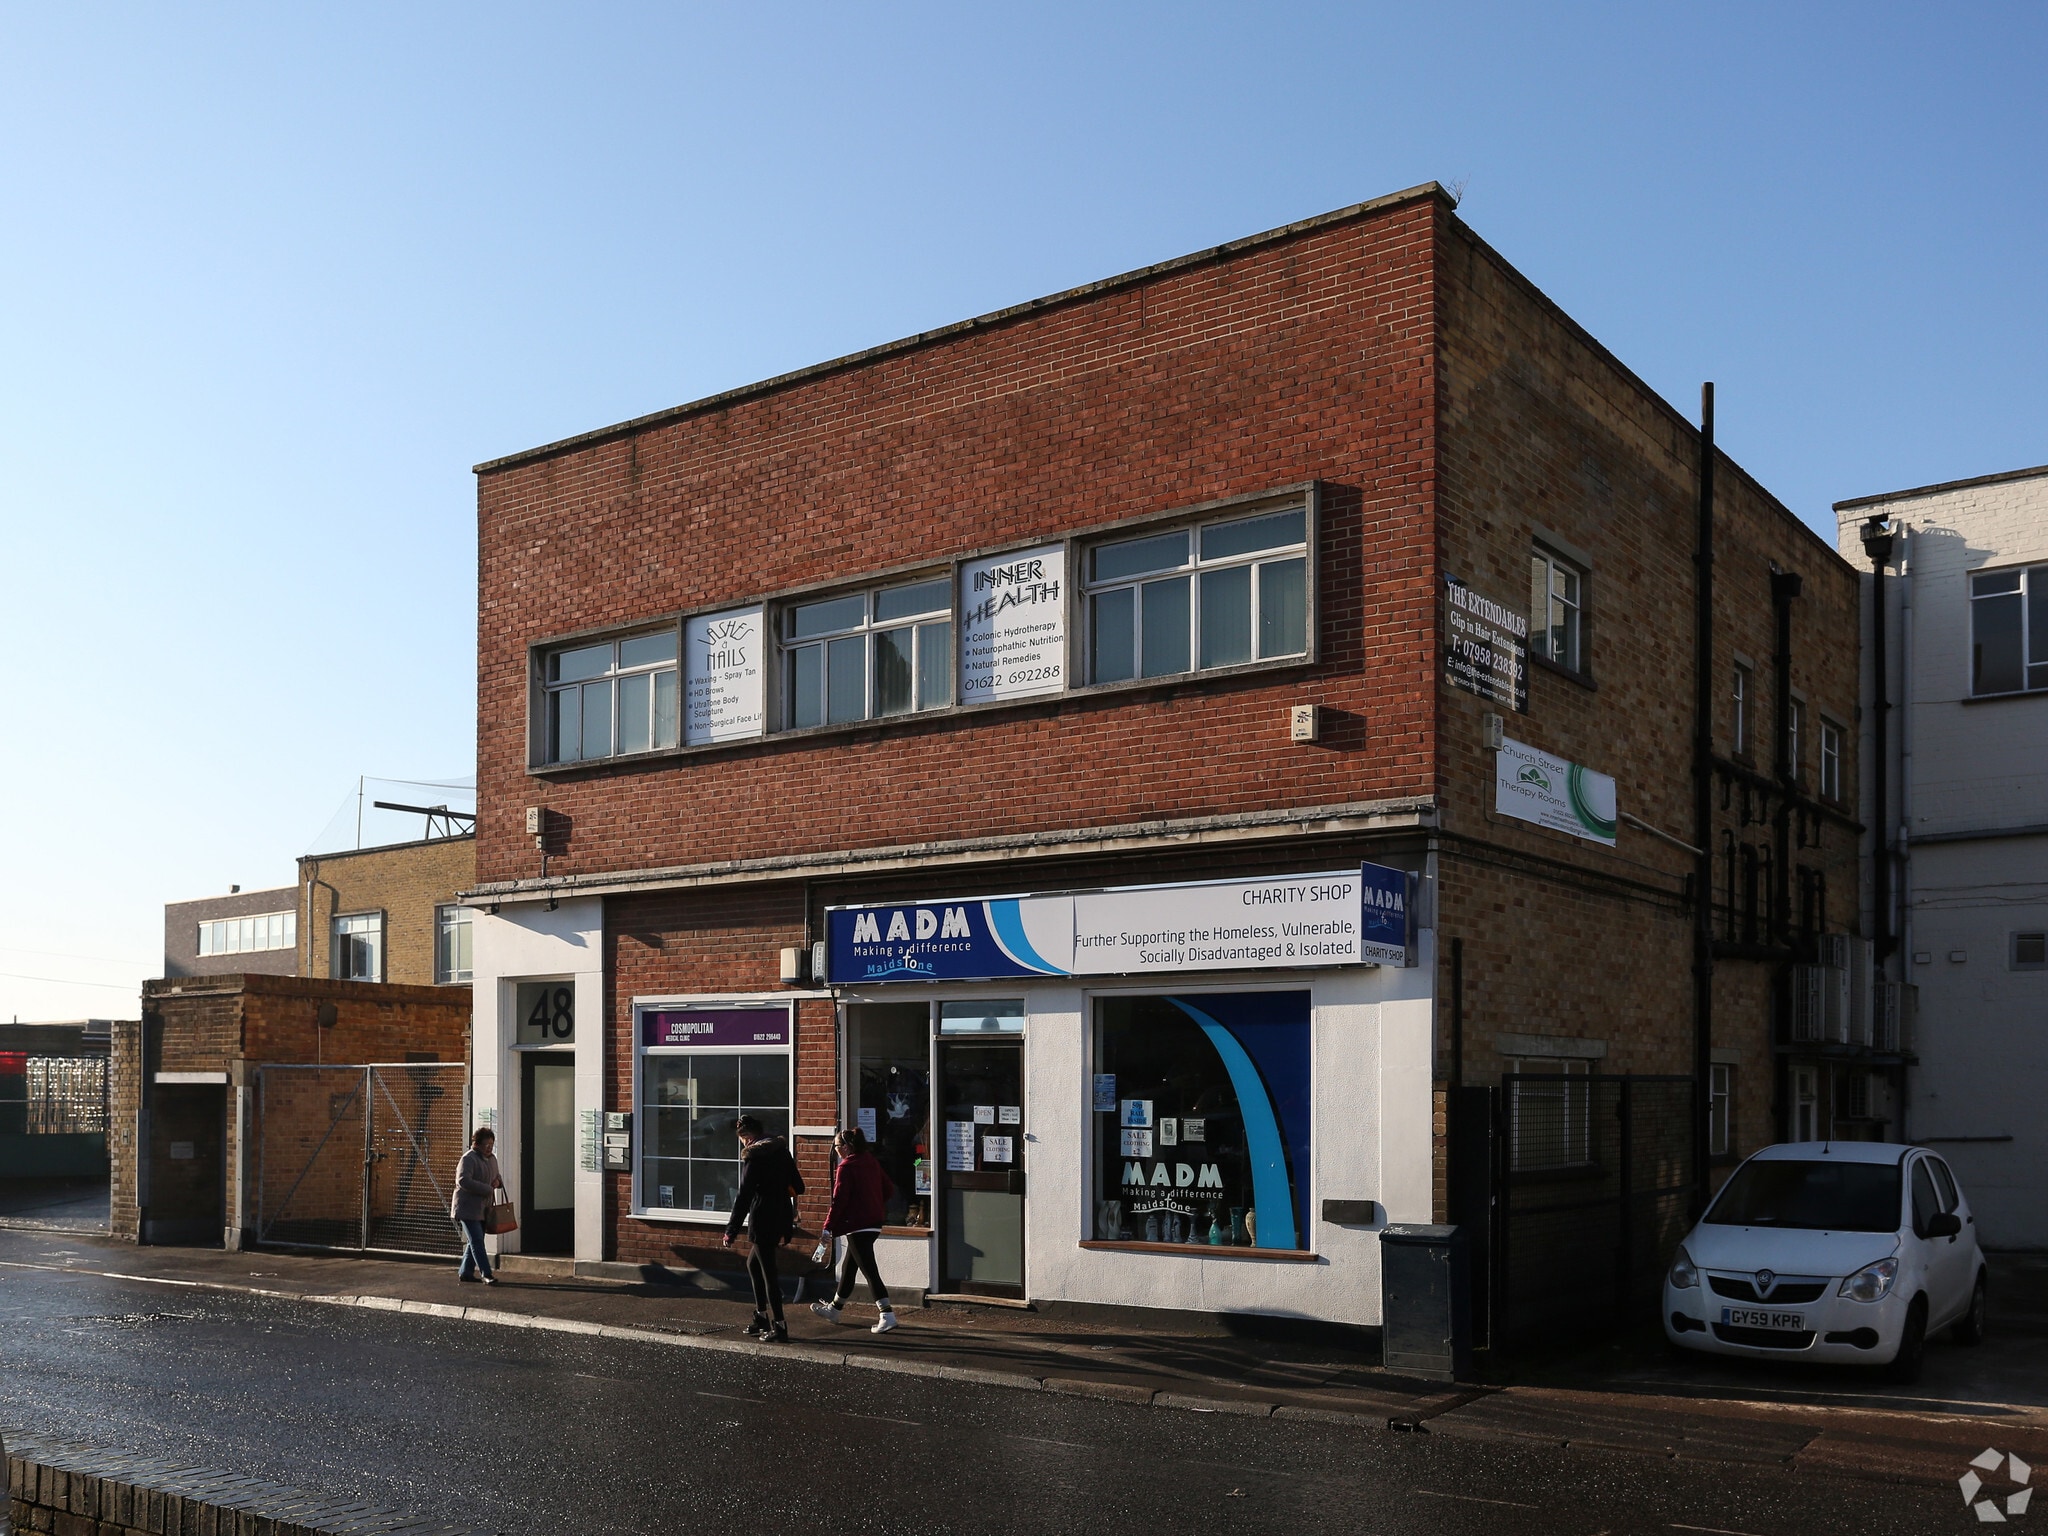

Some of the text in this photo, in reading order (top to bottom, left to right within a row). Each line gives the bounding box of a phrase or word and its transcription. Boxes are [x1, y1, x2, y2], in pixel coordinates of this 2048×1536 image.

[974, 559, 1043, 592] INNER
[963, 580, 1060, 632] HEALTH
[1448, 580, 1526, 638] THE EXTENDABLES
[697, 621, 754, 646] LASHES
[972, 621, 1057, 643] Colonic Hydrotherapy
[1450, 610, 1525, 658] Clip in Hair Extensions
[972, 634, 1064, 656] Naturophathic Nutrition
[707, 647, 746, 671] NAILS
[972, 652, 1041, 671] Natural Remedies
[1447, 656, 1454, 670] E:
[1452, 634, 1523, 681] T: 07958 238392
[694, 676, 717, 686] Waxing
[724, 671, 742, 681] Spray
[744, 668, 756, 676] Tan
[965, 665, 1060, 691] 01622 692288
[694, 686, 724, 697] HD Brows
[722, 696, 739, 705] Body
[694, 708, 724, 718] Sculpture
[694, 716, 735, 731] Non-Surgical
[736, 714, 752, 724] Face
[1502, 744, 1564, 775] Church Street
[1500, 778, 1566, 808] Therapy Rooms
[1242, 884, 1352, 905] CHARITY SHOP
[1364, 885, 1404, 912] MADM
[852, 906, 971, 944] MADM
[1075, 919, 1356, 948] Further Supporting the Homeless, Vulnerable,
[854, 941, 971, 957] Making a difference
[1140, 941, 1356, 964] Socially Disadvantaged & Isolated.
[1365, 945, 1403, 961] CHARITY SHOP
[867, 949, 933, 974] Maidstone
[528, 987, 573, 1038] 48
[671, 1022, 714, 1034] COSMOPOLITAN
[1127, 1131, 1147, 1139] SALE
[1121, 1161, 1223, 1188] MADM
[1122, 1187, 1156, 1198] Making
[1170, 1189, 1223, 1199] difference
[1133, 1193, 1191, 1212] Maidstone
[1732, 1310, 1801, 1328] GY59 KPR
